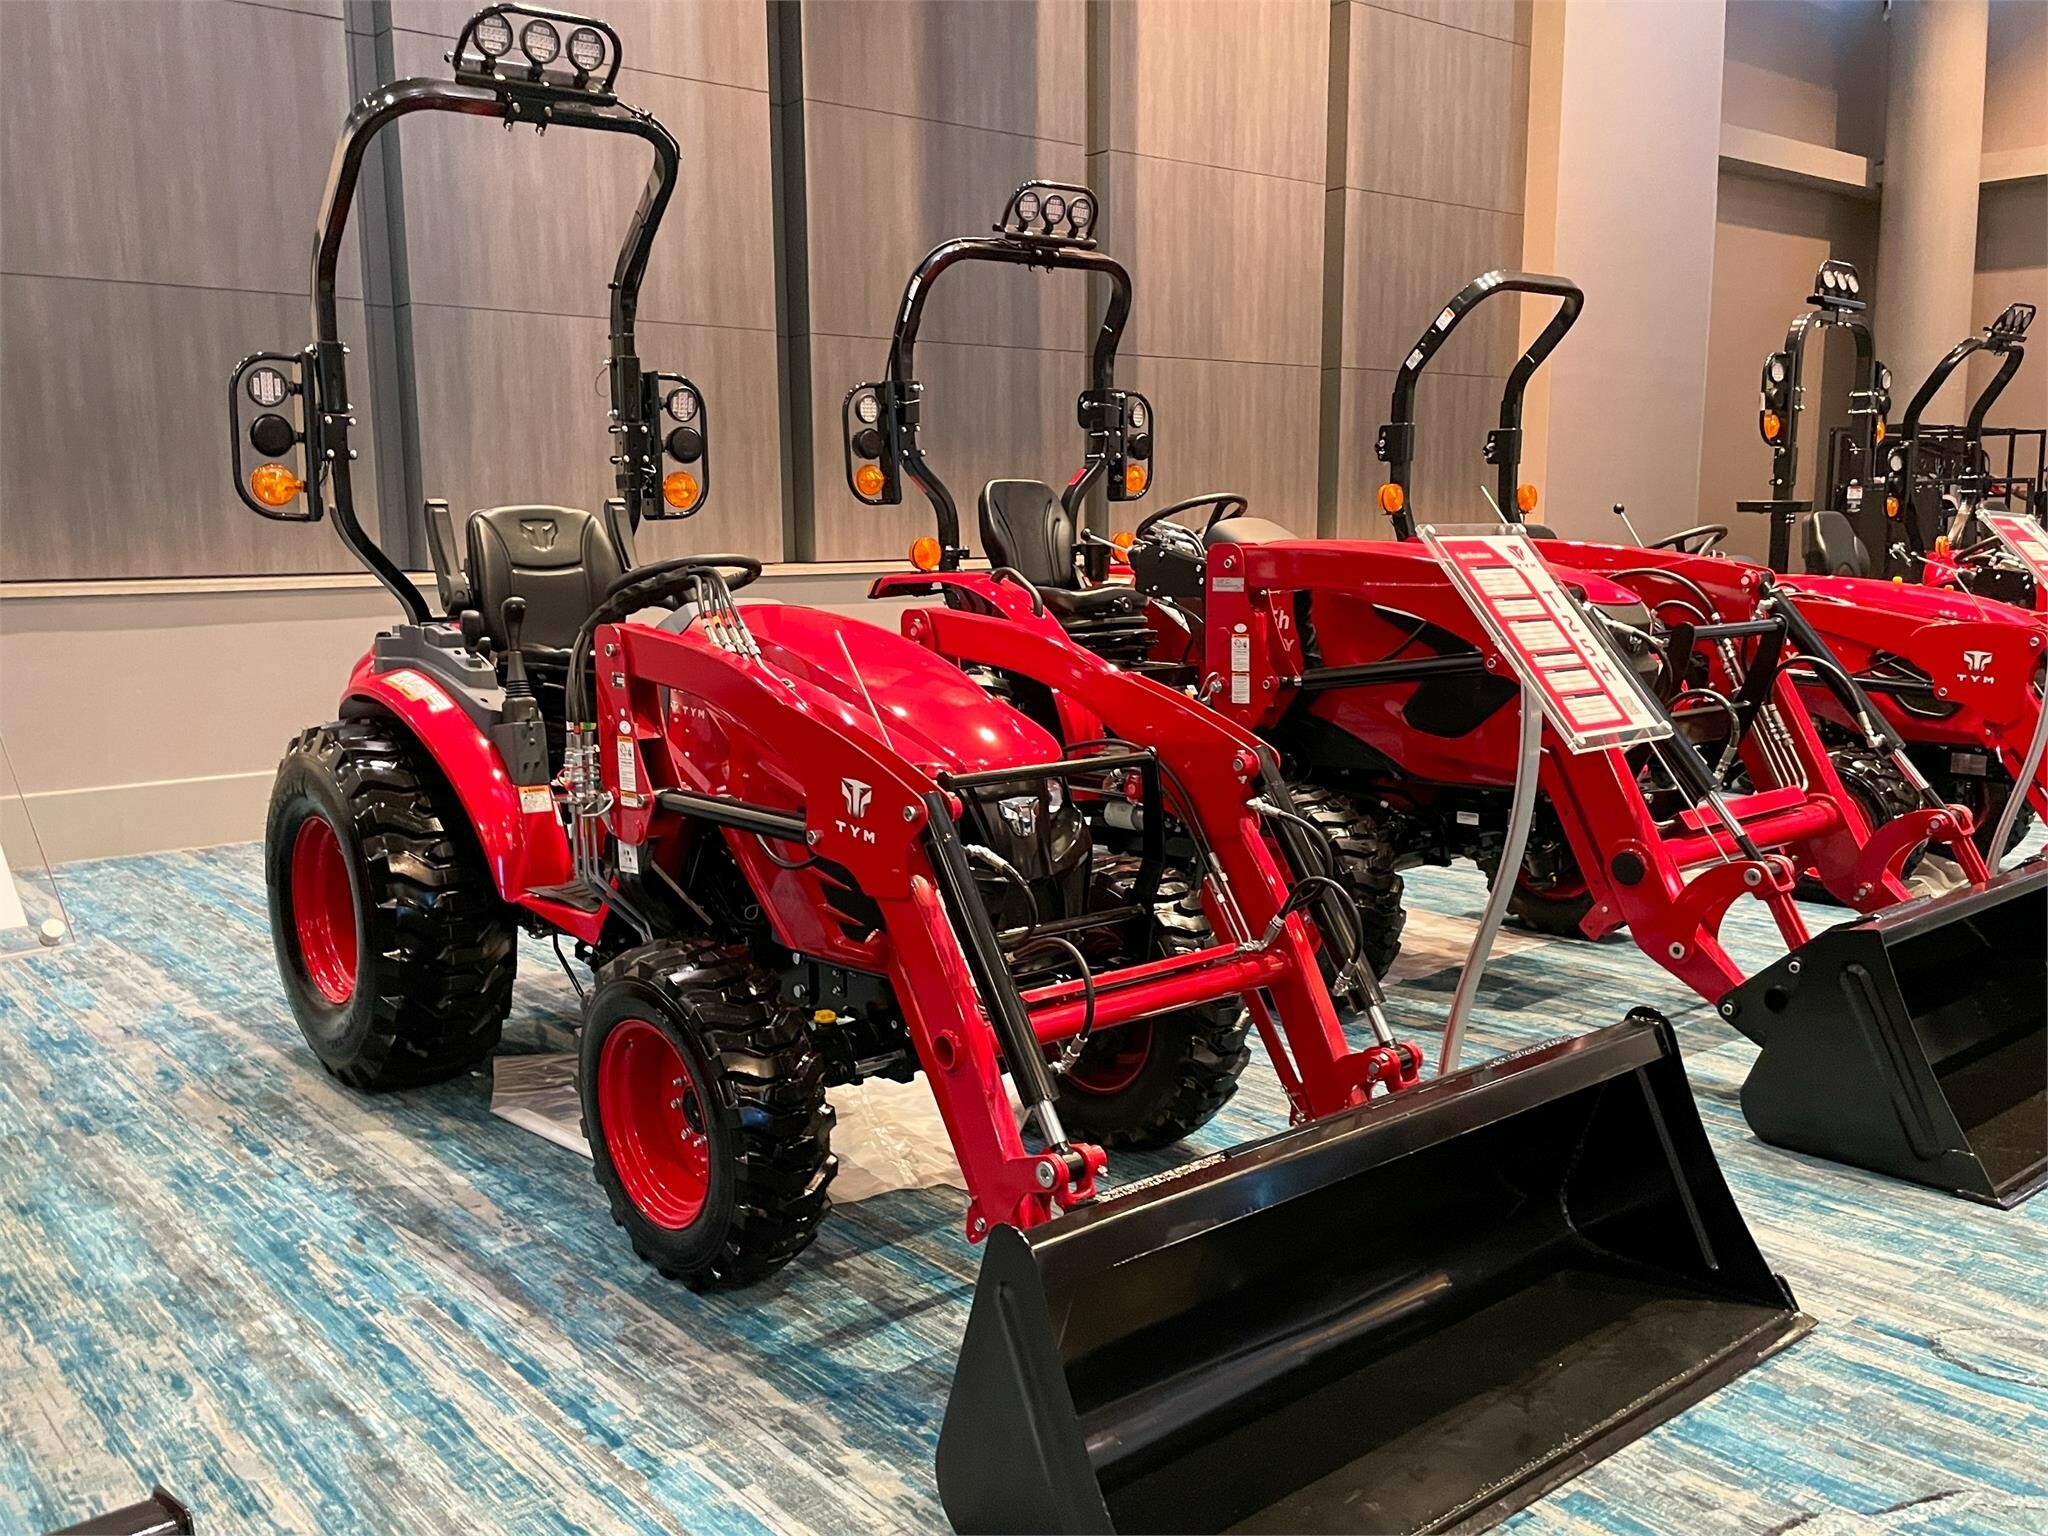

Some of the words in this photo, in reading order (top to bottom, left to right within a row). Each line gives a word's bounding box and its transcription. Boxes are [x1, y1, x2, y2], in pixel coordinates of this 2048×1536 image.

[1956, 673, 1995, 685] TYM
[682, 705, 705, 719] TYM
[835, 819, 876, 844] TYM
